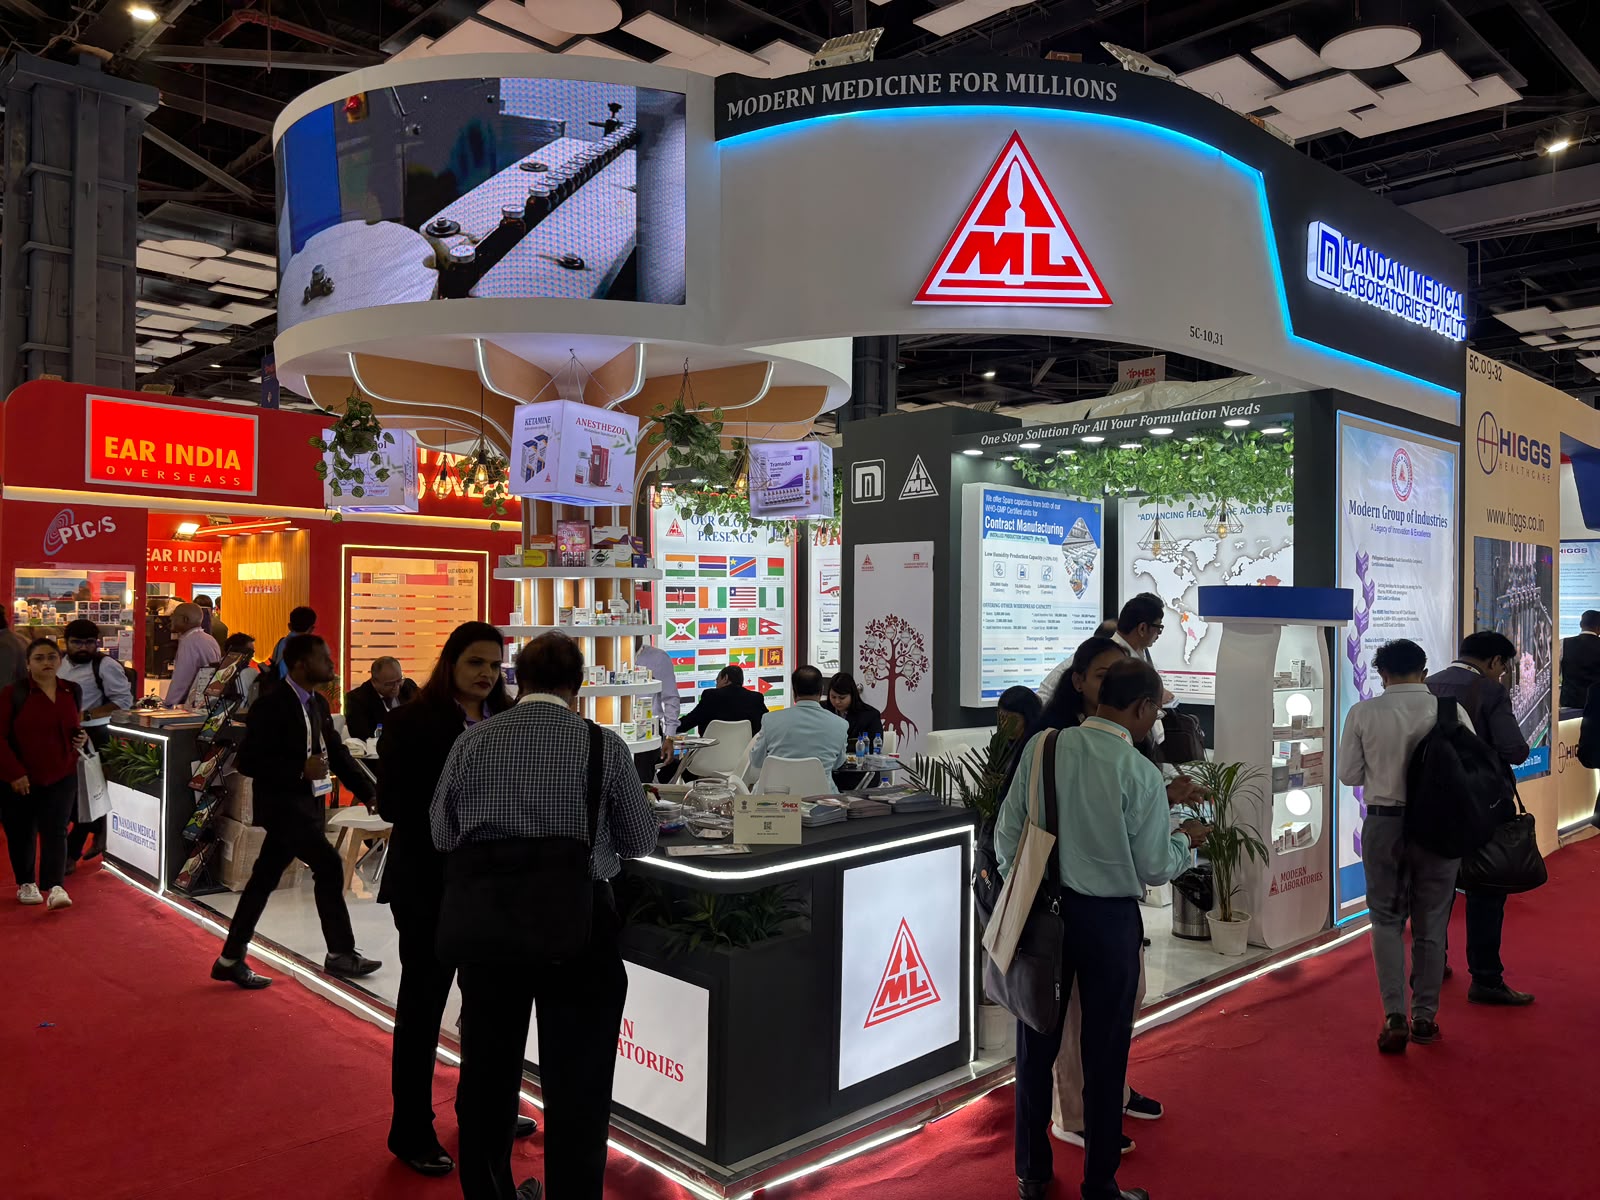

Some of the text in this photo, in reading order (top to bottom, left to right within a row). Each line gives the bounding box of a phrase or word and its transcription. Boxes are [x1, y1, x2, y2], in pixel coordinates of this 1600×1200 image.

[727, 72, 1118, 122] MODERN MEDICINE FOR MILLIONS
[1342, 235, 1468, 321] NANDANI MEDICAL
[1342, 268, 1427, 328] LABORATORIES
[575, 417, 626, 436] ANESTHEZOL
[980, 402, 1261, 446] One Stop Solution For All Your Formulation Needs
[105, 436, 241, 471] EAR INDIA
[1499, 428, 1551, 469] HIGGS
[106, 465, 240, 486] OVERSEASS
[1499, 461, 1551, 484] HEALTHCARE
[985, 515, 1064, 538] Contract Manufacturing
[1348, 499, 1448, 529] Modern Group of Industries
[1486, 507, 1545, 533] www.higgs.co.in
[177, 549, 222, 564] INDIA
[1280, 865, 1307, 882] MODERN
[1280, 871, 1323, 893] LABORATORIES
